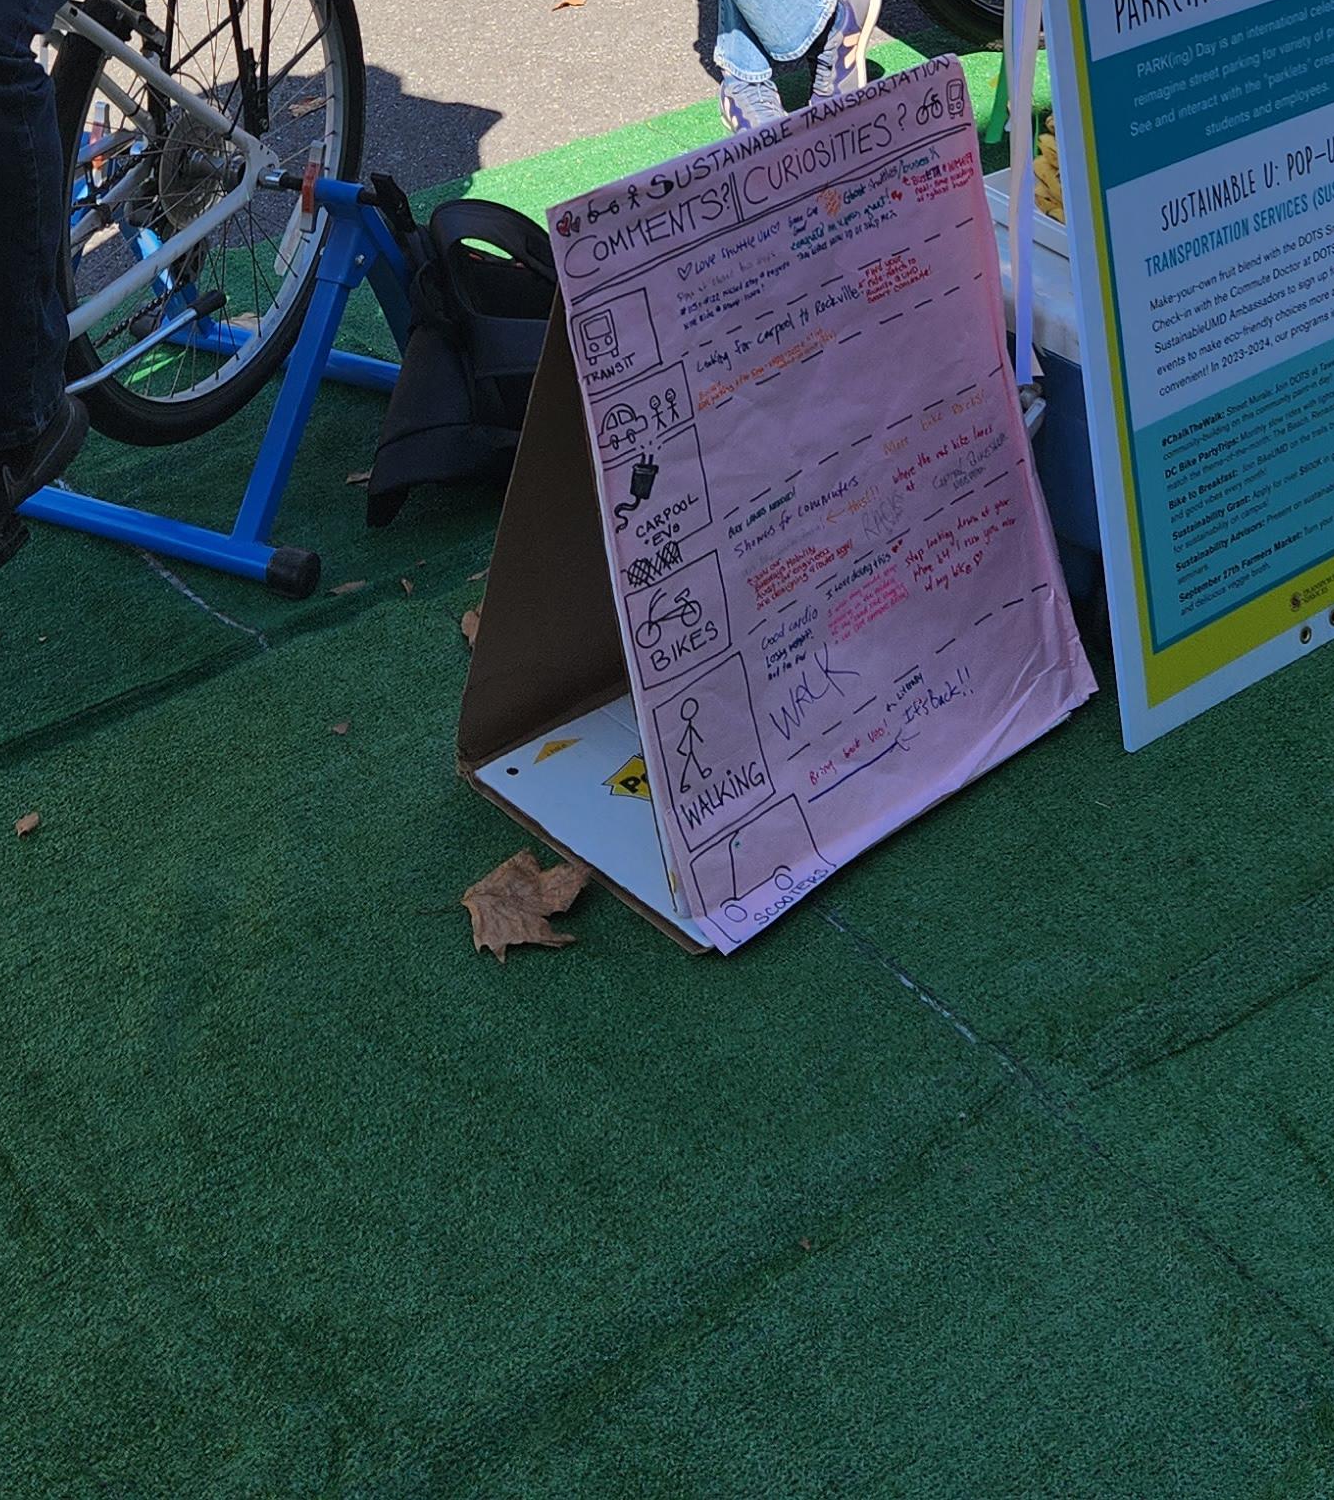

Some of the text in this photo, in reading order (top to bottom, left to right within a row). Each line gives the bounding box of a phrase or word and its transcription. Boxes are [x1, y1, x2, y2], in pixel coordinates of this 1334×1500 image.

[1133, 76, 1186, 112] reimagine
[1188, 64, 1219, 87] street
[1221, 50, 1260, 80] parking
[1262, 44, 1277, 61] for
[1279, 31, 1313, 59] variety
[1314, 27, 1325, 42] of
[1136, 46, 1193, 82] PARK(ing)
[1194, 38, 1217, 62] Day
[1218, 34, 1228, 50] is
[1230, 31, 1244, 46] an
[1245, 6, 1307, 40] international
[648, 55, 951, 201] SUSTAINABLE TRANSPORTATION
[1129, 116, 1151, 137] See
[1153, 107, 1176, 128] and
[1177, 92, 1219, 119] interact
[1220, 83, 1243, 104] with
[1244, 76, 1261, 94] the
[1263, 57, 1312, 92] "parklets"
[1204, 78, 1330, 136] students and employees.
[564, 181, 731, 279] COMMENTS?
[743, 114, 894, 206] CURIOSITIES
[1158, 167, 1256, 232] SUSTAINABLE
[1262, 158, 1280, 191] U:
[1144, 217, 1249, 279] TRANSPORTATION
[1252, 192, 1308, 234] SERVICES
[1149, 273, 1217, 315] Make-your-own
[1218, 265, 1236, 282] fruit
[1237, 254, 1261, 274] blend
[1262, 245, 1281, 263] with
[1282, 239, 1297, 255] the
[1297, 227, 1323, 248] DOTS
[1151, 305, 1192, 333] Check-in
[1193, 297, 1212, 315] with
[1214, 290, 1228, 306] the
[1229, 271, 1271, 299] Commute
[1272, 258, 1301, 280] Doctor
[1302, 254, 1311, 267] at
[583, 355, 636, 386] TRANSIT
[732, 333, 753, 356] for
[754, 311, 796, 353] carpool
[1158, 364, 1209, 397] convenient!
[1211, 359, 1219, 373] In
[1221, 335, 1272, 368] 2023-2024,
[1274, 330, 1289, 344] our
[1290, 312, 1329, 340] programs
[636, 493, 699, 538] CARPOOL
[651, 621, 720, 673] BIKES
[769, 642, 860, 741] WALK
[681, 765, 766, 831] WALKING
[752, 866, 830, 928] SCOOTERS
